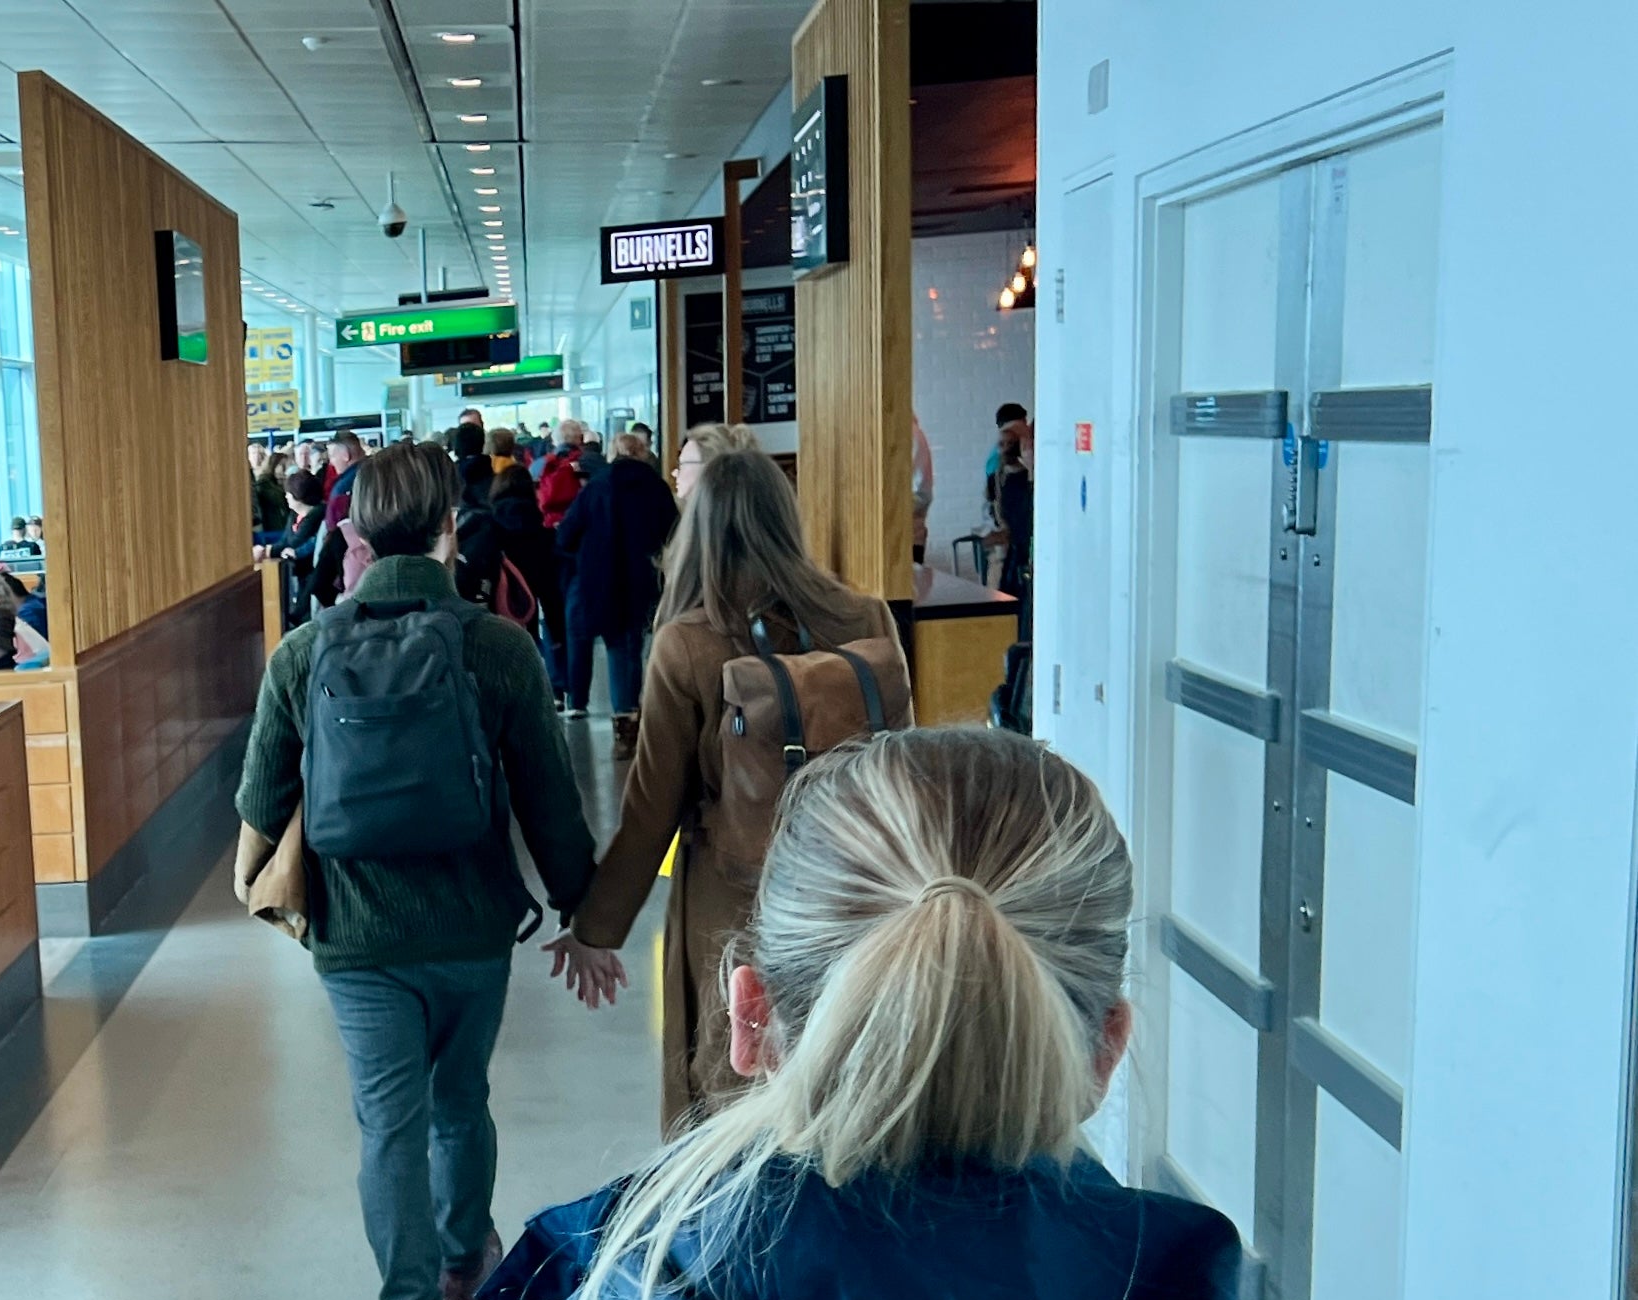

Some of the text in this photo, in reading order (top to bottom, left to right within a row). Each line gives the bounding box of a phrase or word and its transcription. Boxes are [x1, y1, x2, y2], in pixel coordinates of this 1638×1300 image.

[616, 231, 708, 267] BURNELLS
[379, 320, 434, 337] Fire exit
